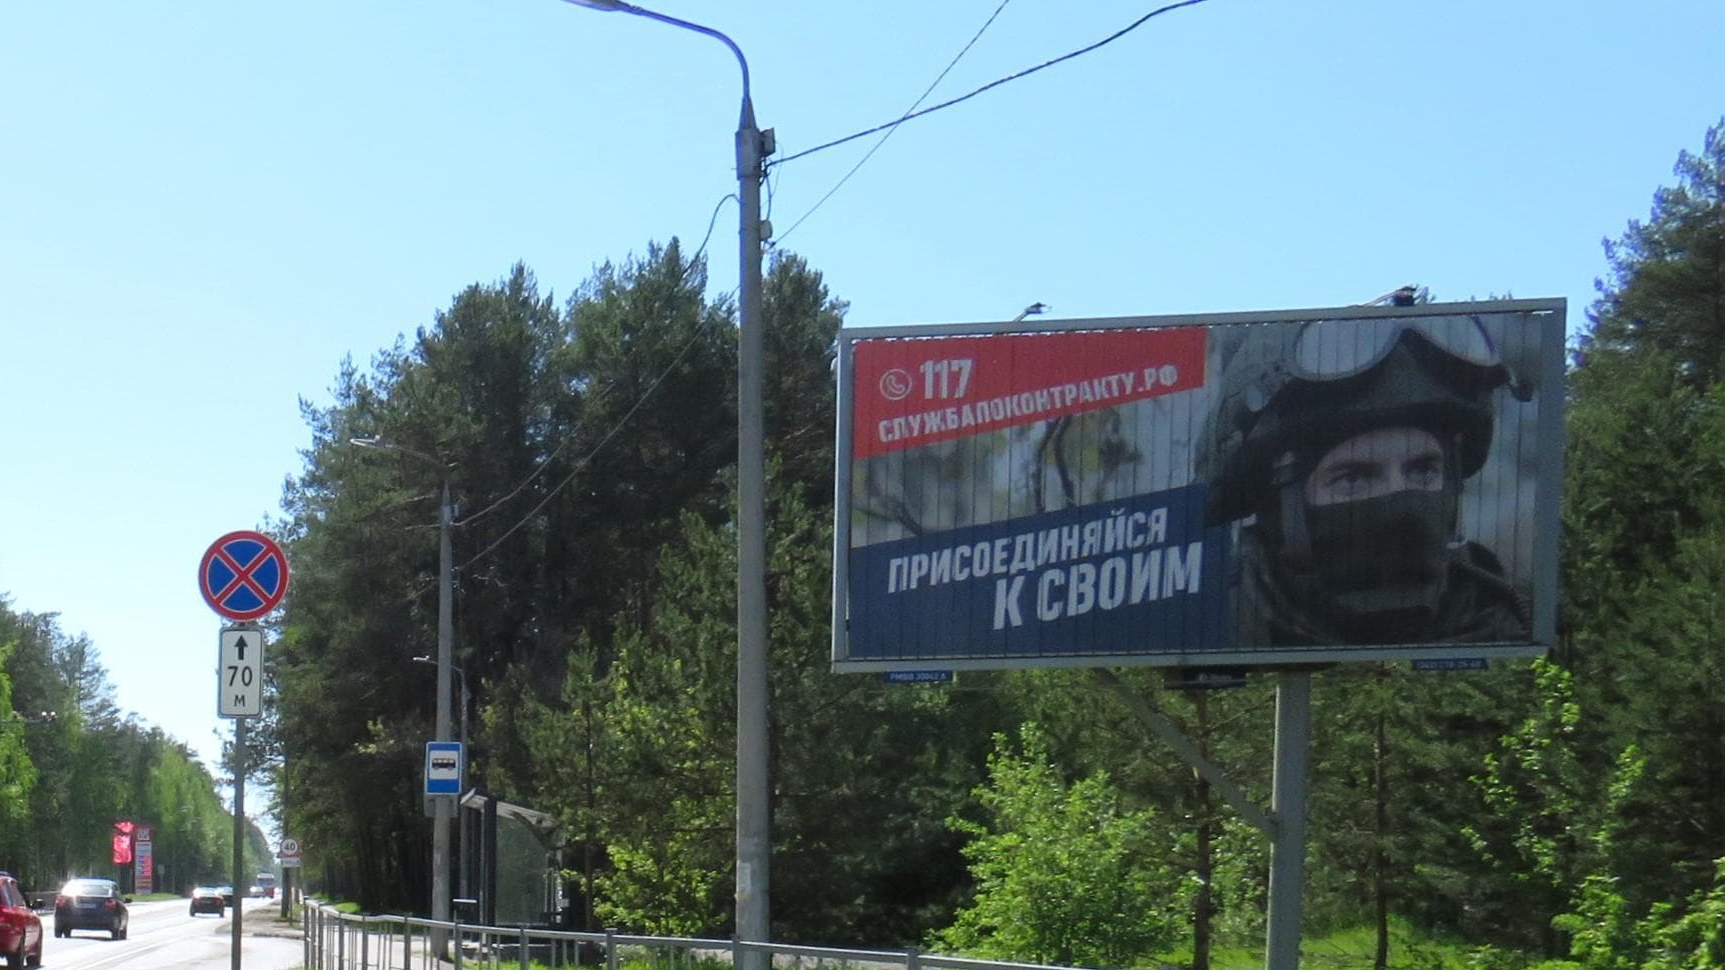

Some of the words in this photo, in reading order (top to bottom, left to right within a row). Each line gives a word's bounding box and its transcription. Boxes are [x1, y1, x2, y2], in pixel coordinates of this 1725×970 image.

[878, 364, 1178, 443] СЛУЖБАПОКОНТРАКТУ.РФ
[920, 359, 973, 400] 117
[888, 507, 1168, 594] ПРИСОЕДИНЯЙСЯ
[993, 575, 1025, 630] К
[1037, 541, 1203, 622] СВОИМ
[228, 666, 253, 687] 70
[284, 842, 295, 851] 40
